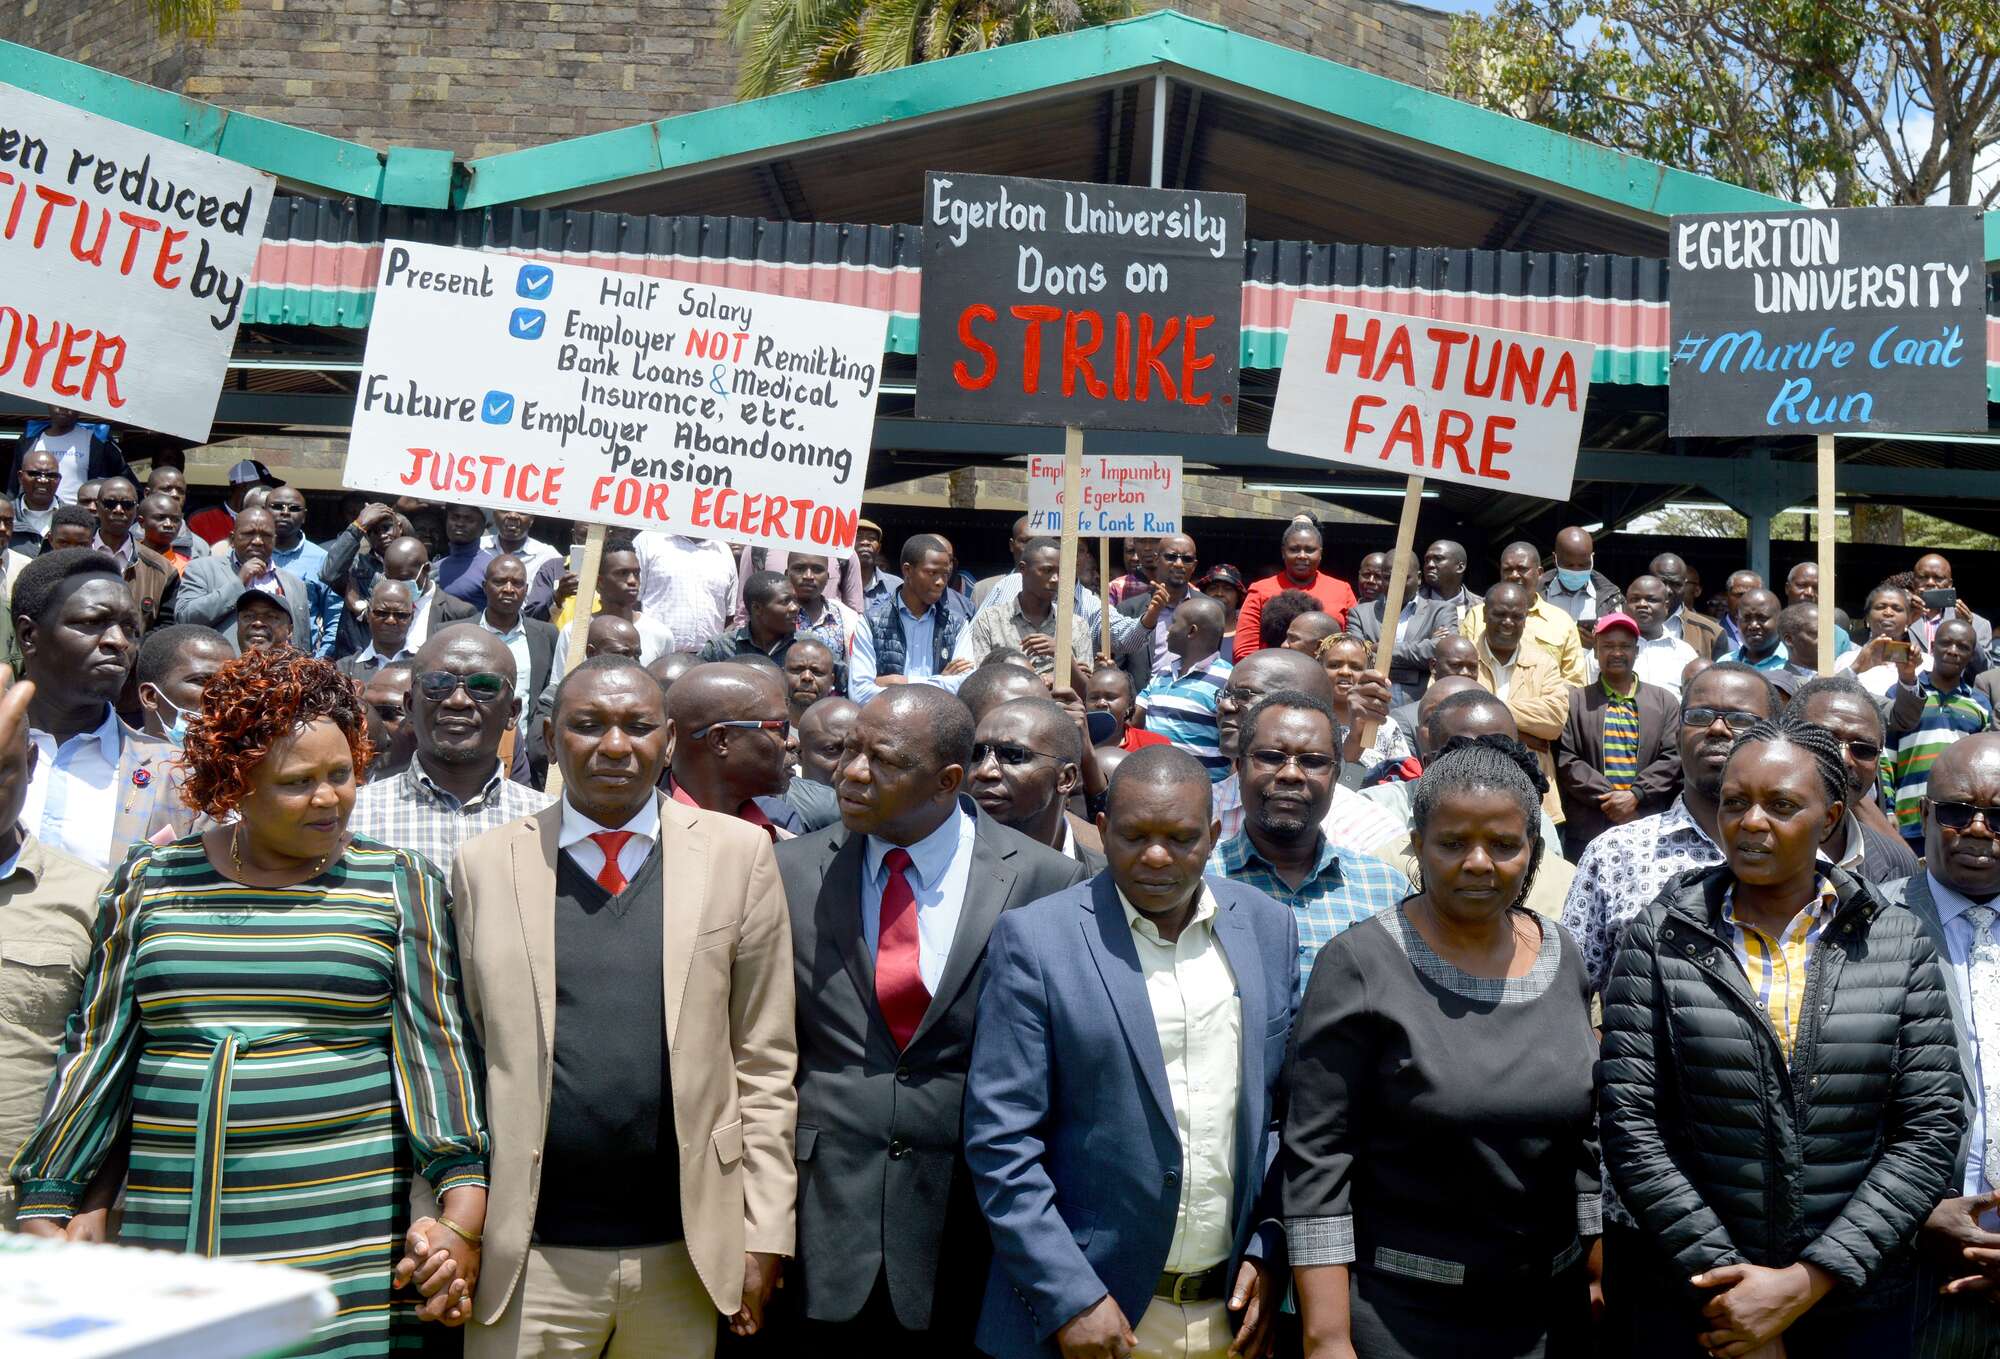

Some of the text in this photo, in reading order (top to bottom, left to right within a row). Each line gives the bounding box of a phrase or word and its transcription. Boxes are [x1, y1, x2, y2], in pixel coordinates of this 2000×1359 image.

[67, 148, 252, 236] reduced
[932, 178, 1227, 259] Egerton University
[1017, 244, 1168, 296] Dons on
[1678, 217, 1840, 271] EGERTON
[190, 238, 243, 331] by
[385, 247, 494, 298] Present
[678, 287, 752, 332] Salary
[1753, 262, 1970, 314] UNIVERSITY
[557, 343, 839, 409] Bank Loans & Medical
[564, 309, 876, 399] Employer NOT Remitting
[1325, 313, 1578, 412] HATUNA
[1868, 324, 1964, 370] Can't
[363, 374, 853, 485] Future Employer Abandoning
[581, 375, 805, 432] Insurance, etc.
[1765, 376, 1874, 427] Run
[610, 442, 734, 489] Pension
[1343, 394, 1517, 481] FARE
[399, 447, 859, 549] JUSTICE FOR EGERTON
[1031, 457, 1171, 490] Empler Impunity
[1084, 486, 1145, 511] Egerton
[1144, 512, 1175, 533] Run
